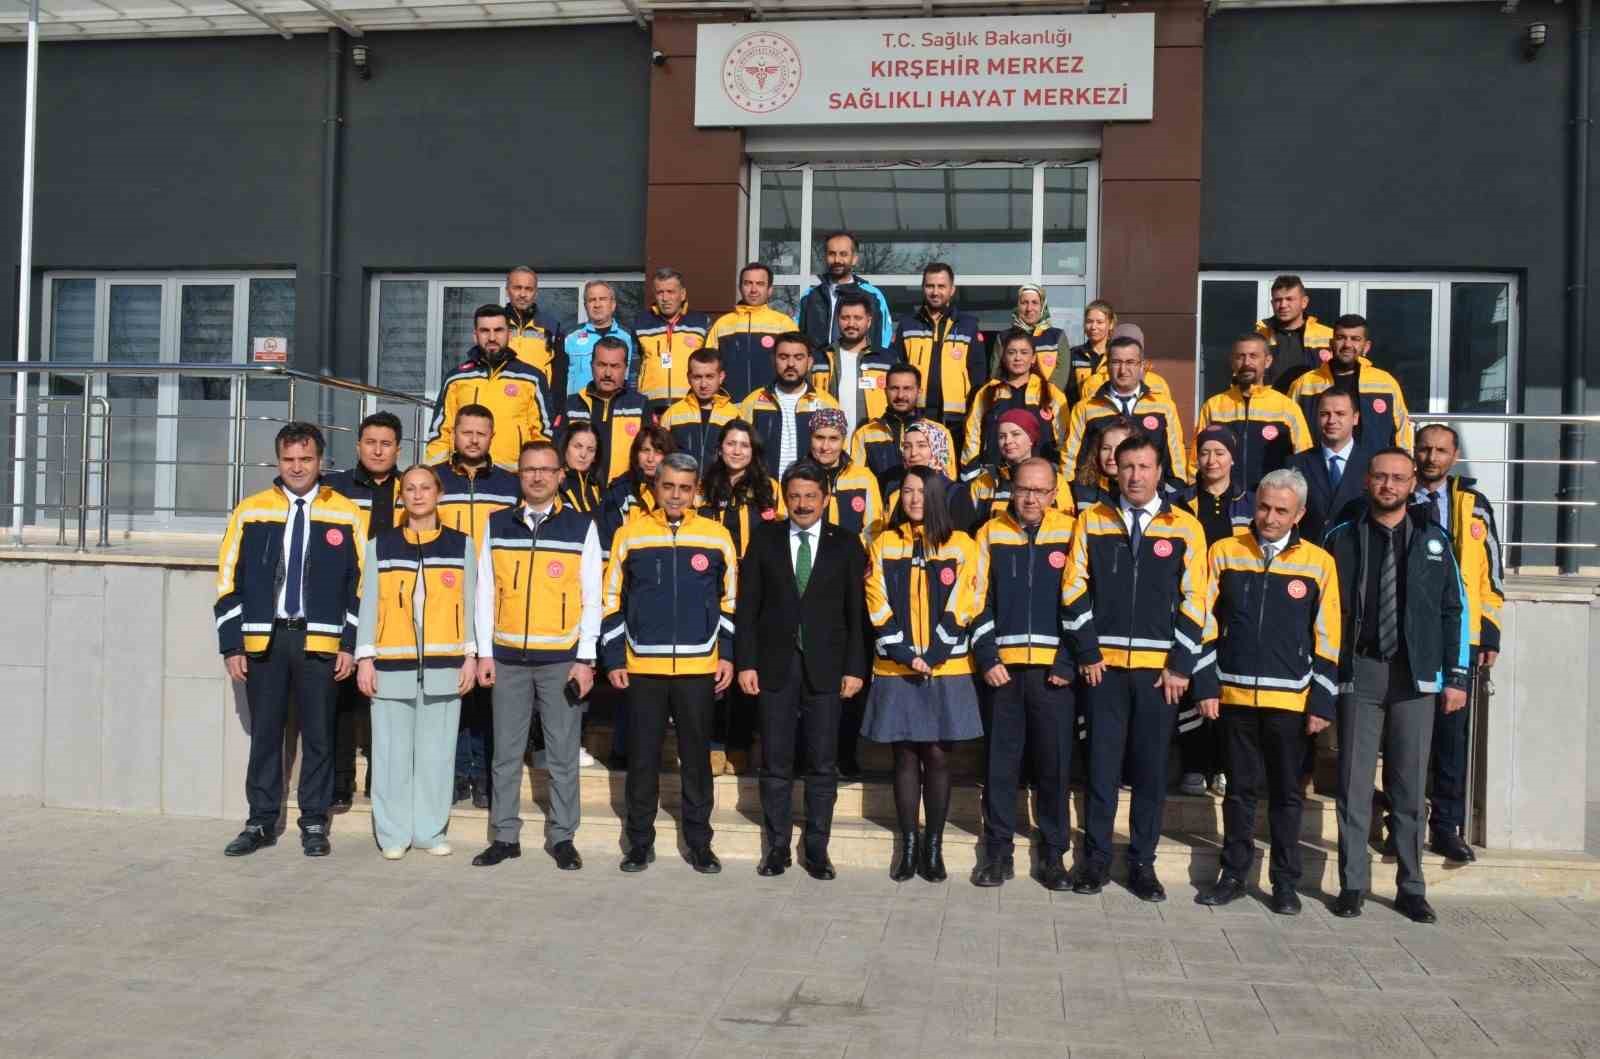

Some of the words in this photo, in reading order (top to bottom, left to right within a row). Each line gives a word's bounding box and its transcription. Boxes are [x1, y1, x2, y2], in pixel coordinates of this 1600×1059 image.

[882, 32, 915, 48] T.C.
[921, 31, 979, 50] Sağlık
[985, 28, 1072, 47] Bakanlığı
[871, 55, 980, 79] KIRŞEHİR
[987, 56, 1085, 75] MERKEZ
[829, 88, 932, 109] SAĞLIKLI
[941, 89, 1017, 107] HAYAT
[1023, 83, 1128, 106] MERKEZİ
